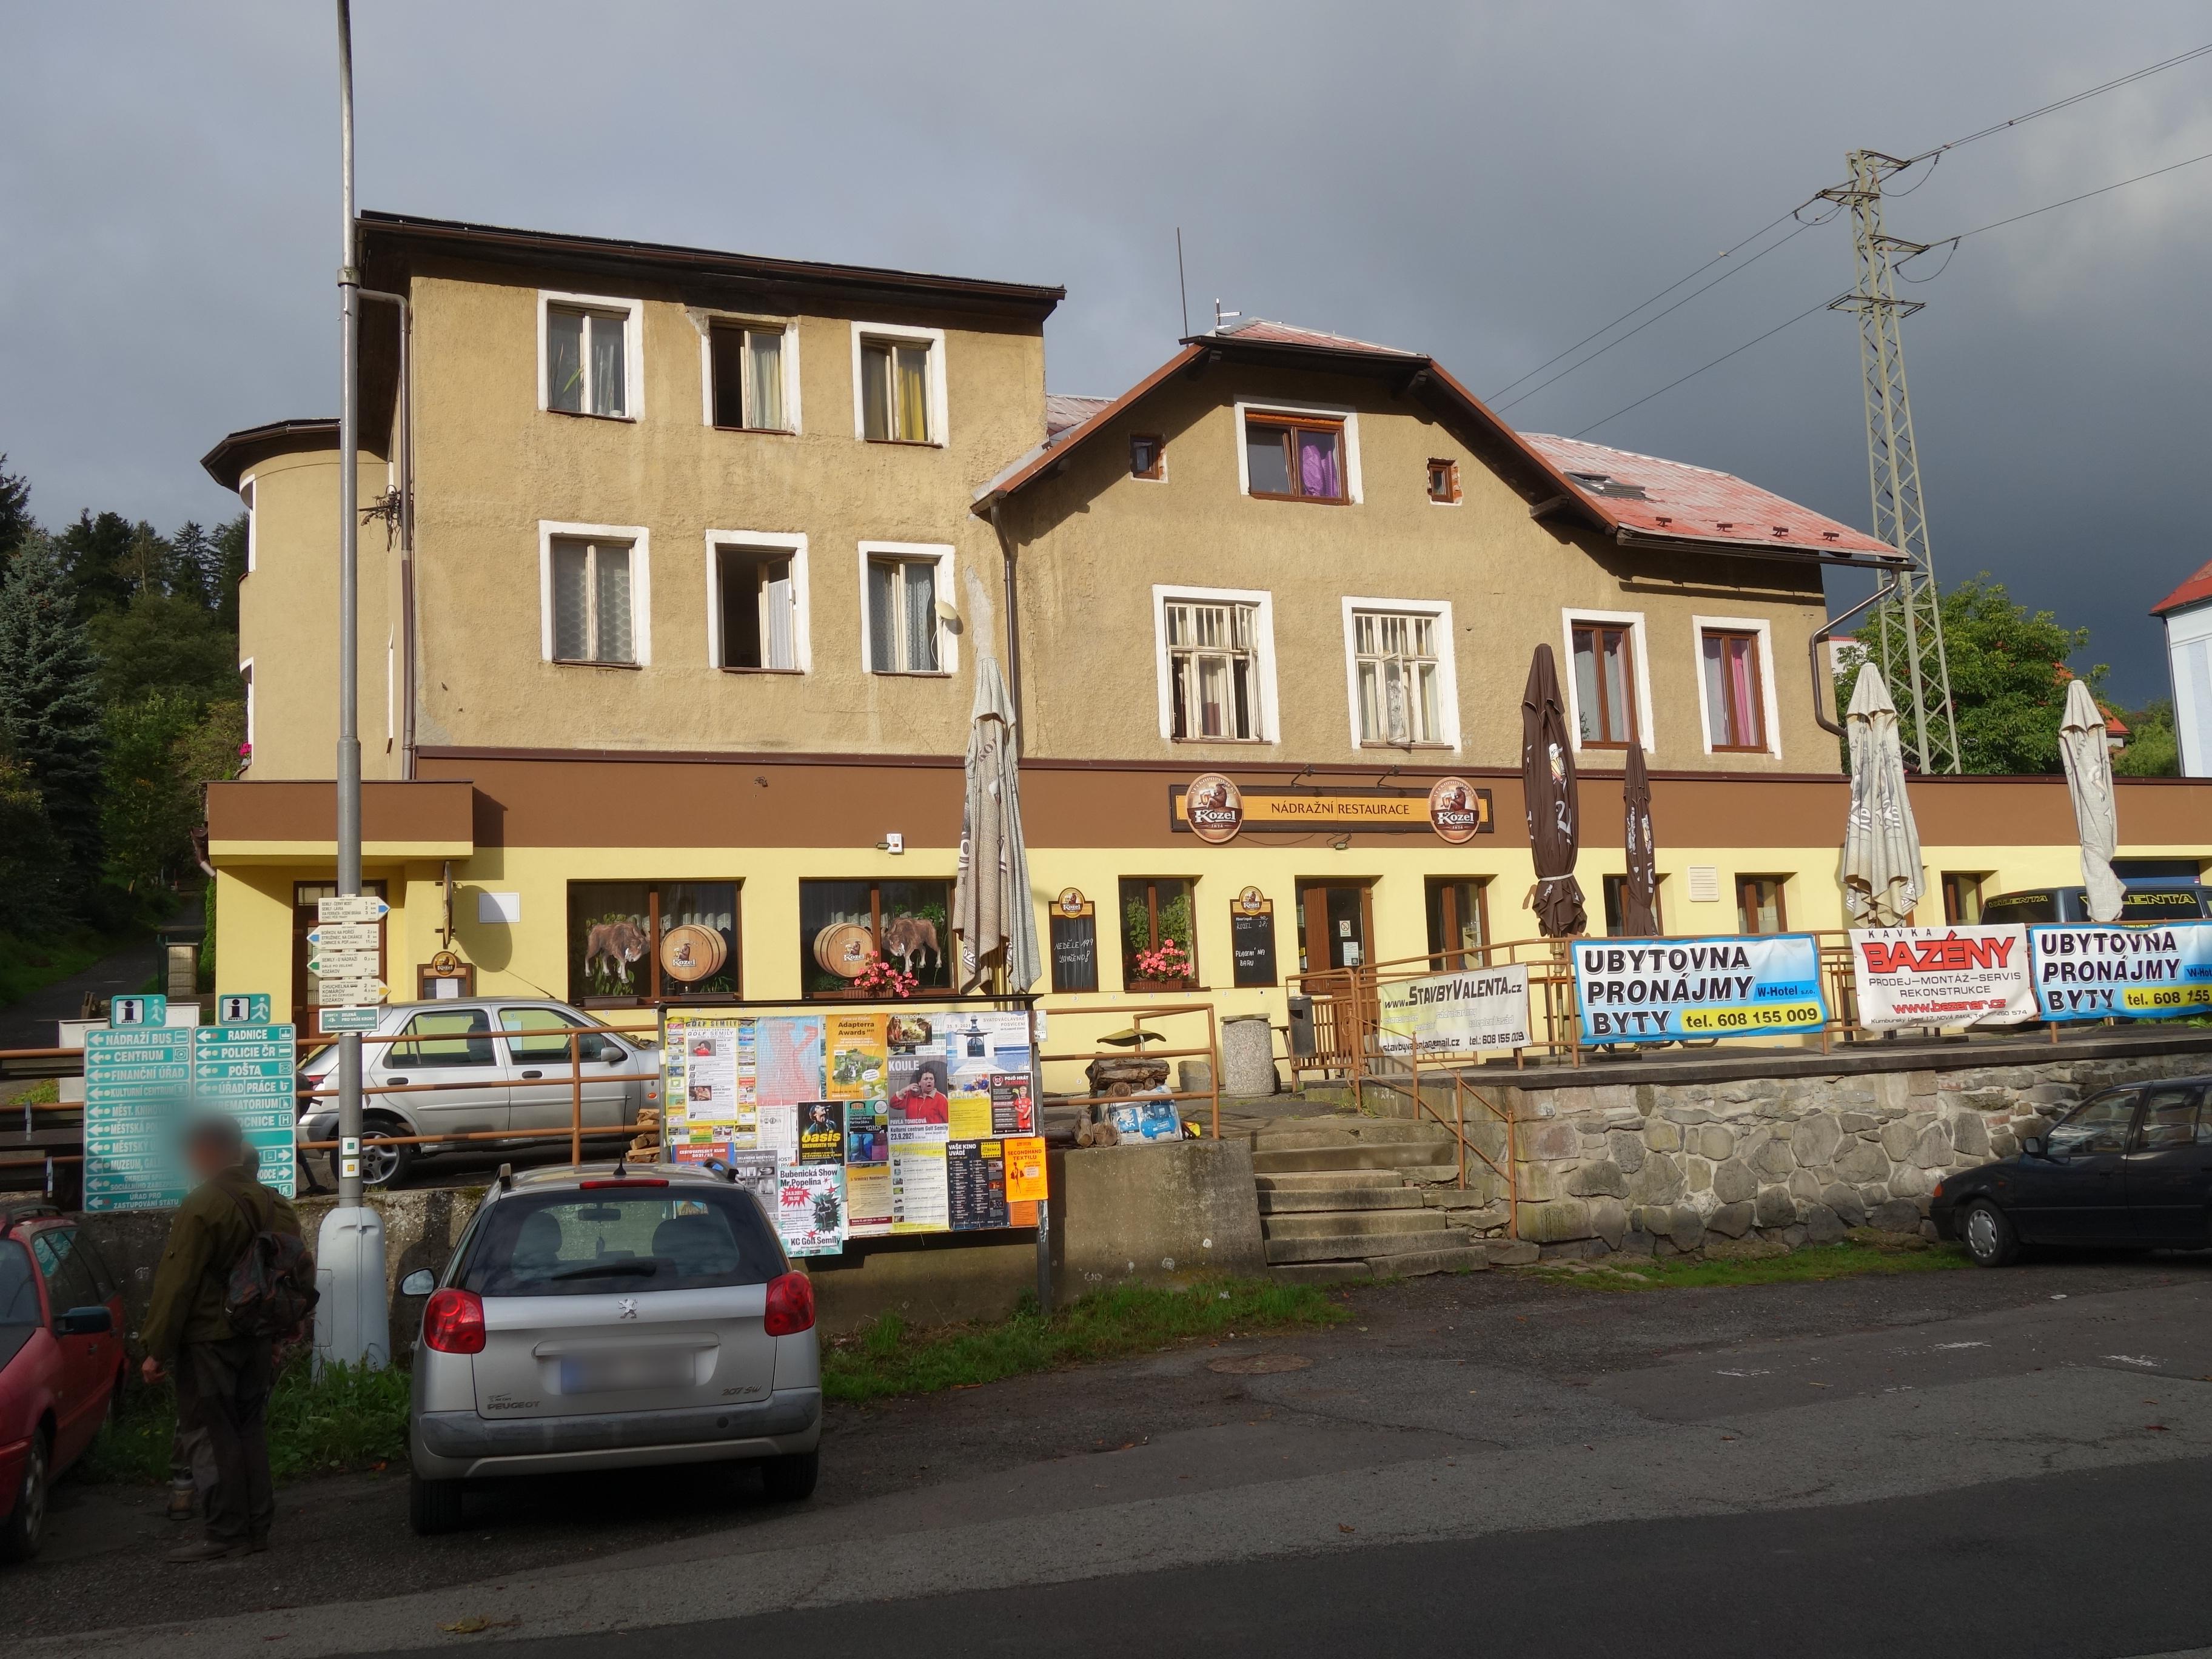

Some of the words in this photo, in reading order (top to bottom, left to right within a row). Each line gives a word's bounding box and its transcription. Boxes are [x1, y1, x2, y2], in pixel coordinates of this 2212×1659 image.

[1271, 800, 1333, 814] NÁDRAŽNÍ
[1338, 803, 1410, 815] RESTAURACE
[1194, 809, 1236, 823] Kozel
[1436, 811, 1475, 825] Kozel
[1868, 928, 1932, 939] KAVKA
[1054, 938, 1080, 951] NEDĚLE
[2040, 931, 2179, 956] UBYTOVNA
[843, 953, 865, 962] Kozel
[1860, 929, 2016, 973] BAZÉNY
[672, 959, 697, 967] Kozel
[1584, 946, 1751, 974] UBYTOVNA
[2042, 955, 2182, 984] PRONÁJMY
[2186, 968, 2212, 977] W-Hot
[1587, 972, 1755, 1006] PRONÁJMY
[1757, 985, 1798, 997] W-Hotel
[1900, 985, 1991, 997] REKONSTRUKCE
[1892, 998, 2007, 1014] www.bazenar.cz
[2047, 988, 2116, 1012] BYTY
[2127, 993, 2149, 1005] tel.
[2153, 991, 2181, 1005] 608
[2187, 990, 2210, 1003] 155
[1592, 1010, 1672, 1036] BYTY
[1686, 1014, 1713, 1028] tel.
[1717, 1013, 1748, 1027] 608
[1752, 1010, 1782, 1024] 155
[1786, 1007, 1818, 1022] 009
[106, 1031, 150, 1046] NÁDRAŽÍ
[152, 1033, 172, 1045] BUS
[227, 1030, 268, 1041] RADNICE
[1482, 1034, 1496, 1045] 608
[1498, 1033, 1510, 1044] 155
[1510, 1031, 1525, 1042] 009
[113, 1050, 164, 1062] CENTRUM
[221, 1047, 260, 1058] POLICIE
[261, 1044, 276, 1057] ČR
[228, 1061, 261, 1076] POŠTA
[888, 1060, 920, 1071] KOULE
[111, 1066, 156, 1081] FINANČNÍ
[159, 1066, 184, 1079] ÚŘAD
[110, 1085, 143, 1098] KULTURNÍ
[218, 1081, 243, 1094] ÚŘAD
[246, 1079, 276, 1093] PRÁCE
[110, 1121, 144, 1134] MĚSTSKÁ
[235, 1116, 275, 1127] OCNICE
[801, 1130, 841, 1143] oasis
[110, 1159, 143, 1172] MUZEUM,
[780, 1168, 817, 1178] Bubenická
[818, 1168, 838, 1176] Show
[129, 1192, 147, 1201] ÚŘAD
[113, 1199, 158, 1209] ZASTUPOVÁNÍ
[801, 1237, 816, 1245] Golf
[816, 1236, 841, 1245] Semily
[721, 1387, 743, 1396] 207
[487, 1401, 540, 1410] PEUGEOT
